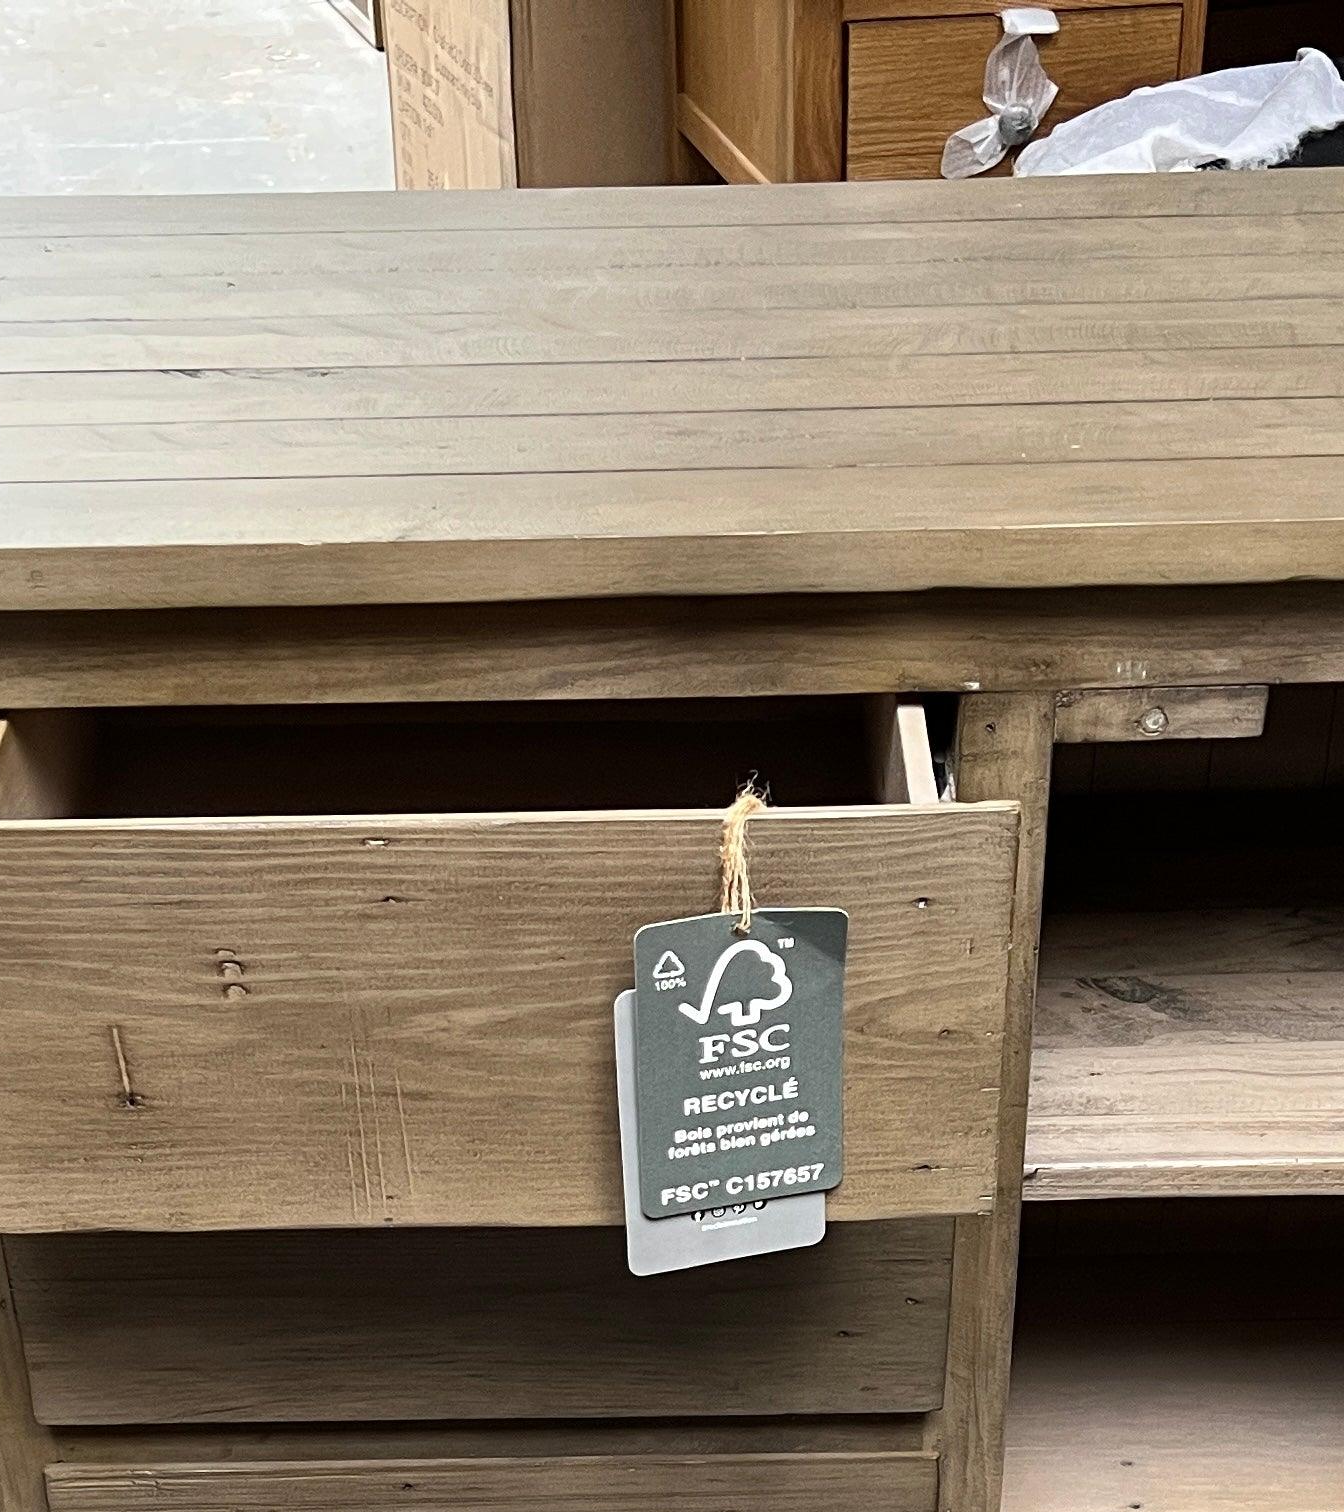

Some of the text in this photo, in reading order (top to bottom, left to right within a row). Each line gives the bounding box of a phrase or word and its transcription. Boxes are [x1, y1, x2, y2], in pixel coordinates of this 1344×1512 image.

[654, 976, 687, 992] 100%
[698, 1023, 791, 1064] FSC
[699, 1056, 791, 1081] www.fsc.org
[683, 1076, 799, 1116] RECYCLÉ
[667, 1124, 816, 1160] forêts bien gérées
[674, 1110, 810, 1144] Bois provient de
[725, 1162, 825, 1195] C157657
